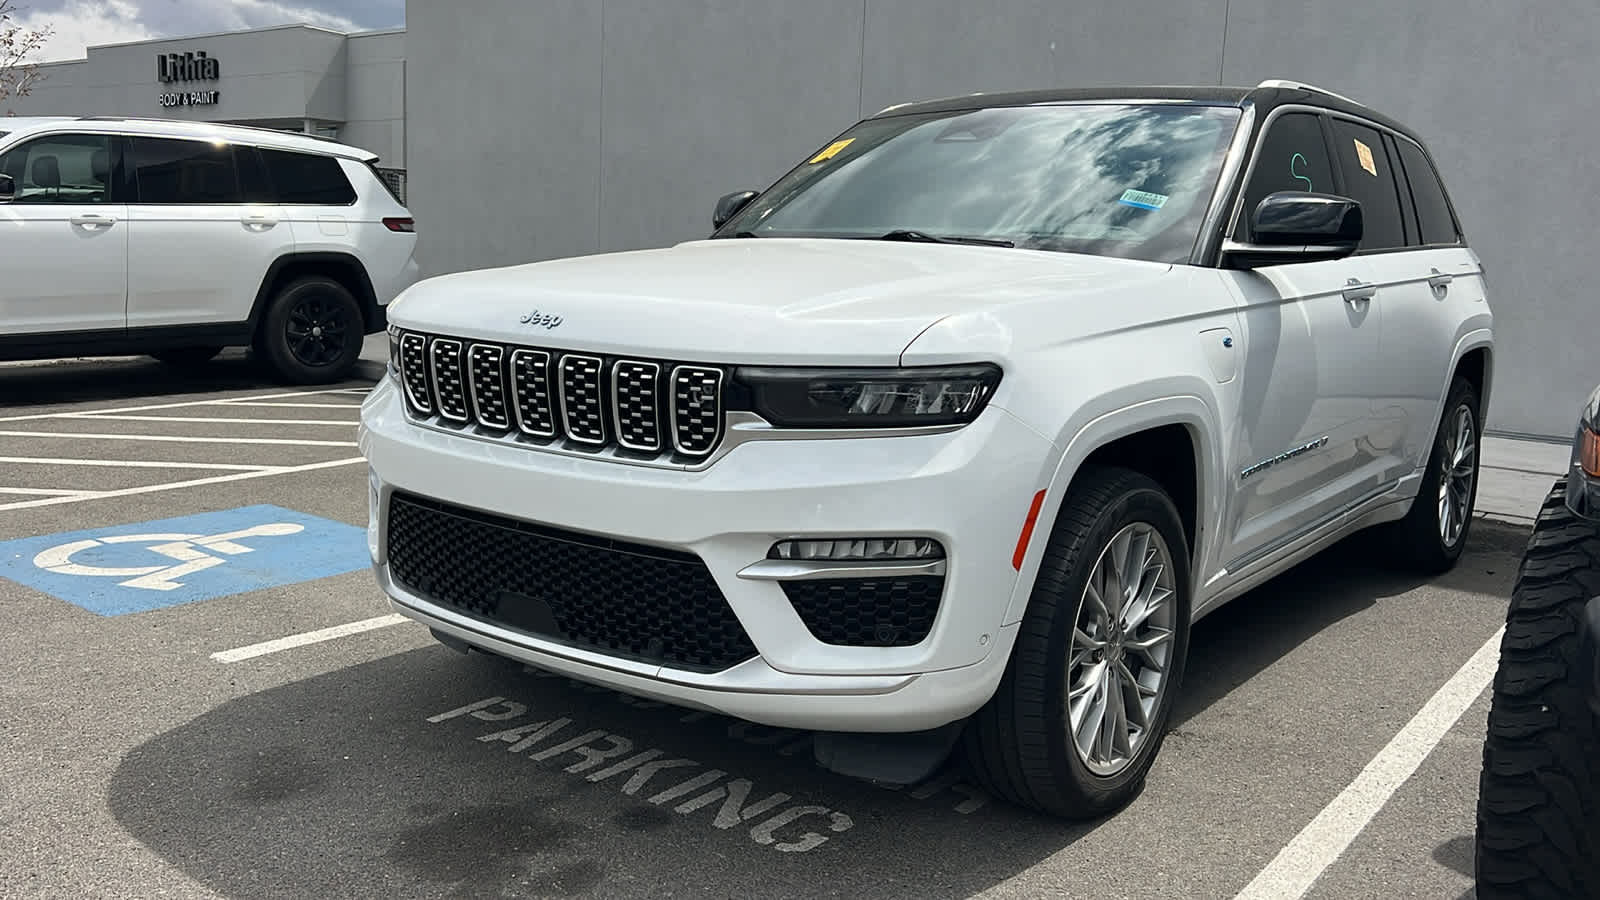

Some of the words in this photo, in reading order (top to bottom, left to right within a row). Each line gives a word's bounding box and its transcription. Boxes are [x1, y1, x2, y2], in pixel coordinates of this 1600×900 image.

[157, 51, 219, 82] Lithia
[159, 93, 181, 106] BODY
[182, 92, 189, 105] &
[190, 91, 216, 105] PAINT
[519, 309, 563, 329] Jeep
[425, 696, 854, 853] PARKING
